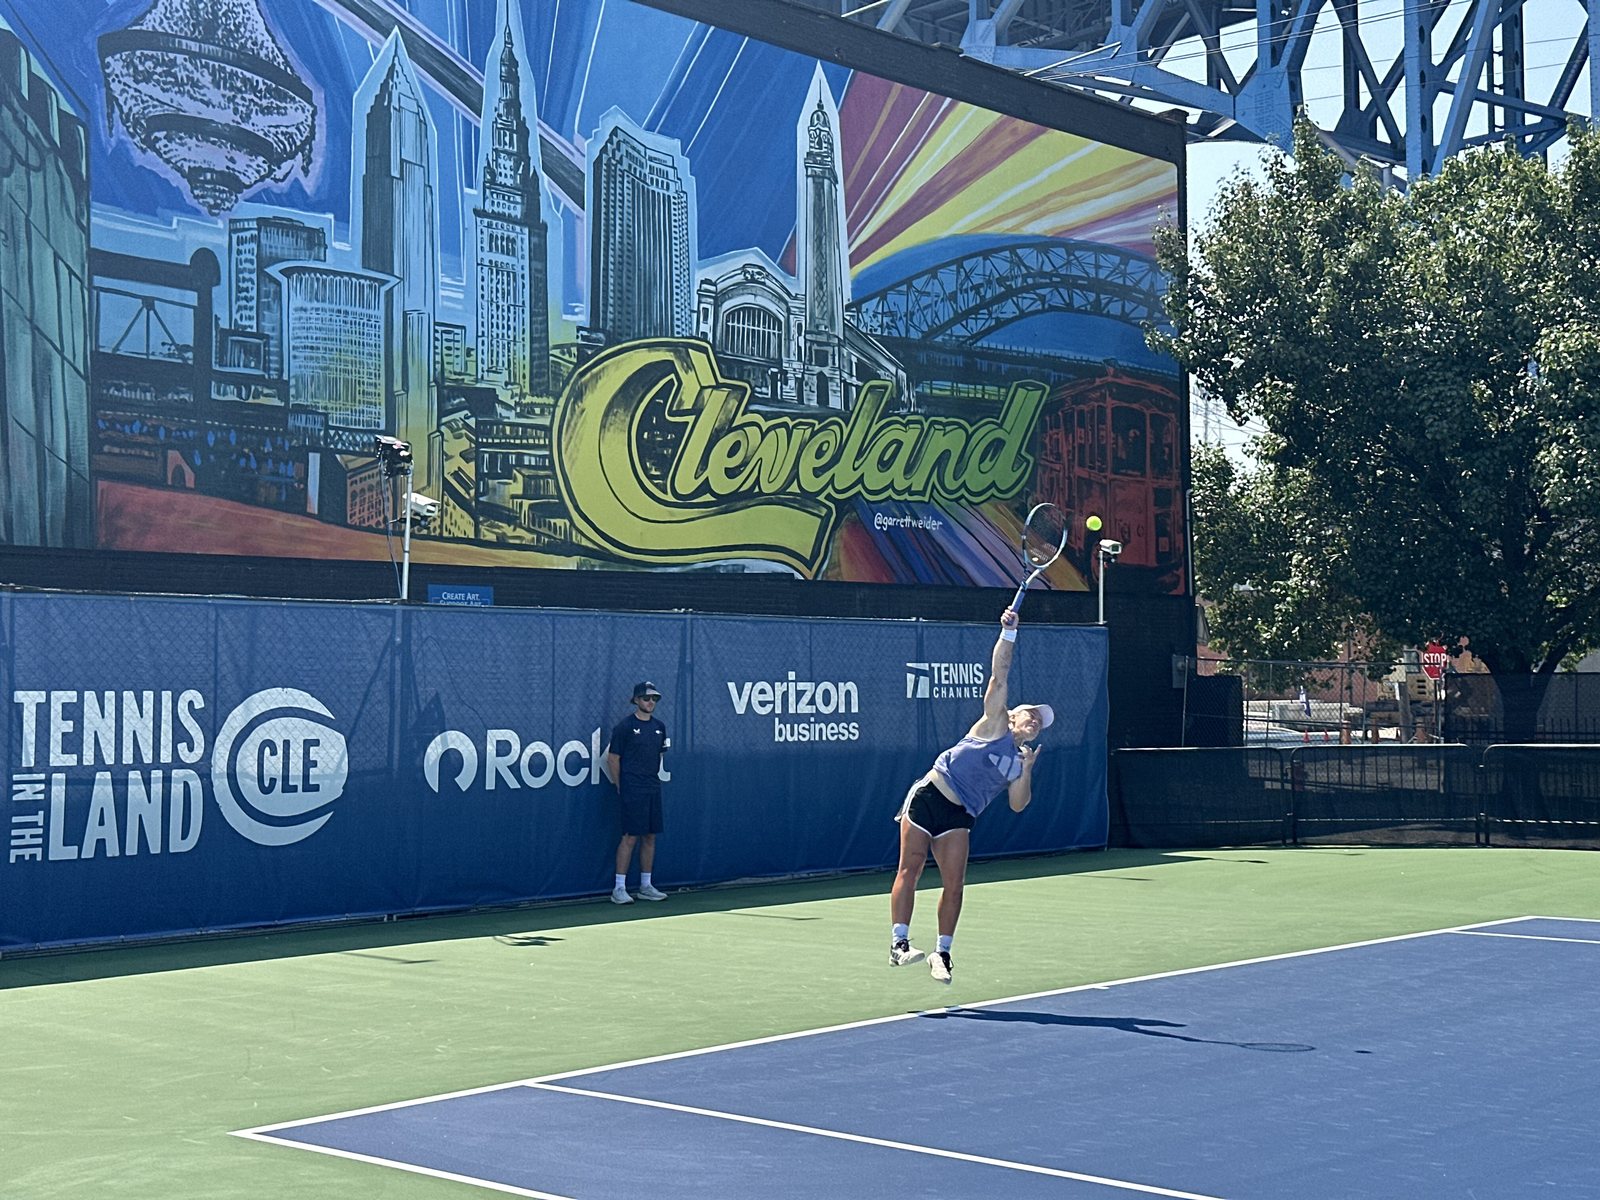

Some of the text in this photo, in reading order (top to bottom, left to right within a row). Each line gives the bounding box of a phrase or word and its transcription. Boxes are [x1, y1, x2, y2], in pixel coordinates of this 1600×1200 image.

[551, 337, 1050, 581] Cleveland
[873, 512, 943, 531] @garrettweider
[931, 662, 984, 685] TENNIS
[1423, 653, 1447, 667] STOP
[727, 671, 859, 715] verizon
[933, 687, 983, 699] CHANNEL
[13, 689, 206, 768] TENNIS
[774, 717, 860, 742] business
[256, 738, 321, 795] CLE
[9, 773, 46, 863] IN THE
[48, 768, 204, 861] LAND
